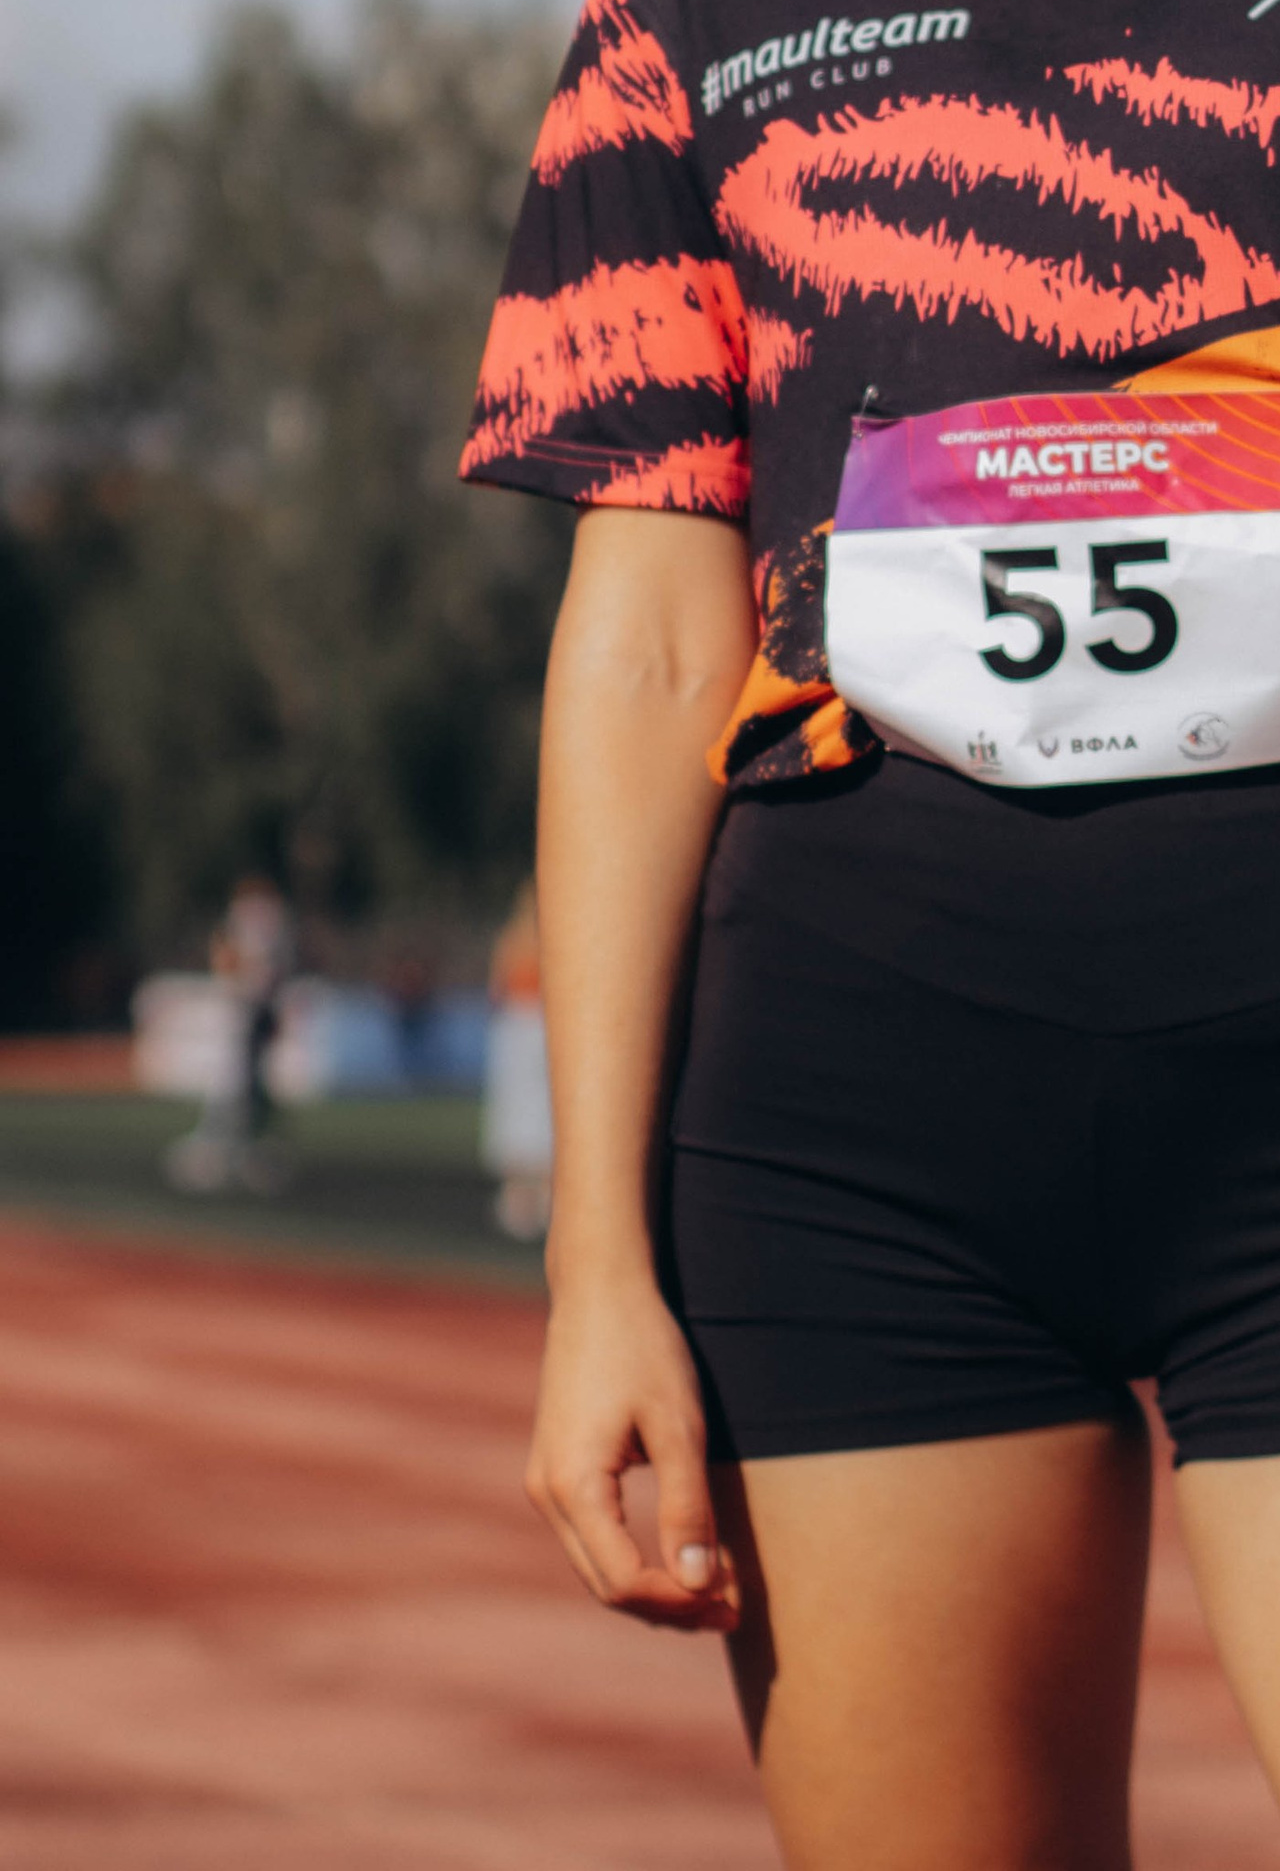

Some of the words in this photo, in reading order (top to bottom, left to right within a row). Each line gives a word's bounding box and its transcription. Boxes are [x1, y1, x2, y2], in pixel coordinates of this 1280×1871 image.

[700, 8, 971, 116] #maulteam
[742, 80, 792, 117] RUN
[809, 56, 893, 90] CLUB
[938, 426, 1013, 446] ЧЕМПИОНАТ
[976, 440, 1170, 480] МАСТЕРС
[1008, 482, 1062, 498] ЛЕГКАЯ
[1065, 477, 1141, 495] АТЛЕТИКА
[977, 537, 1179, 683] 55
